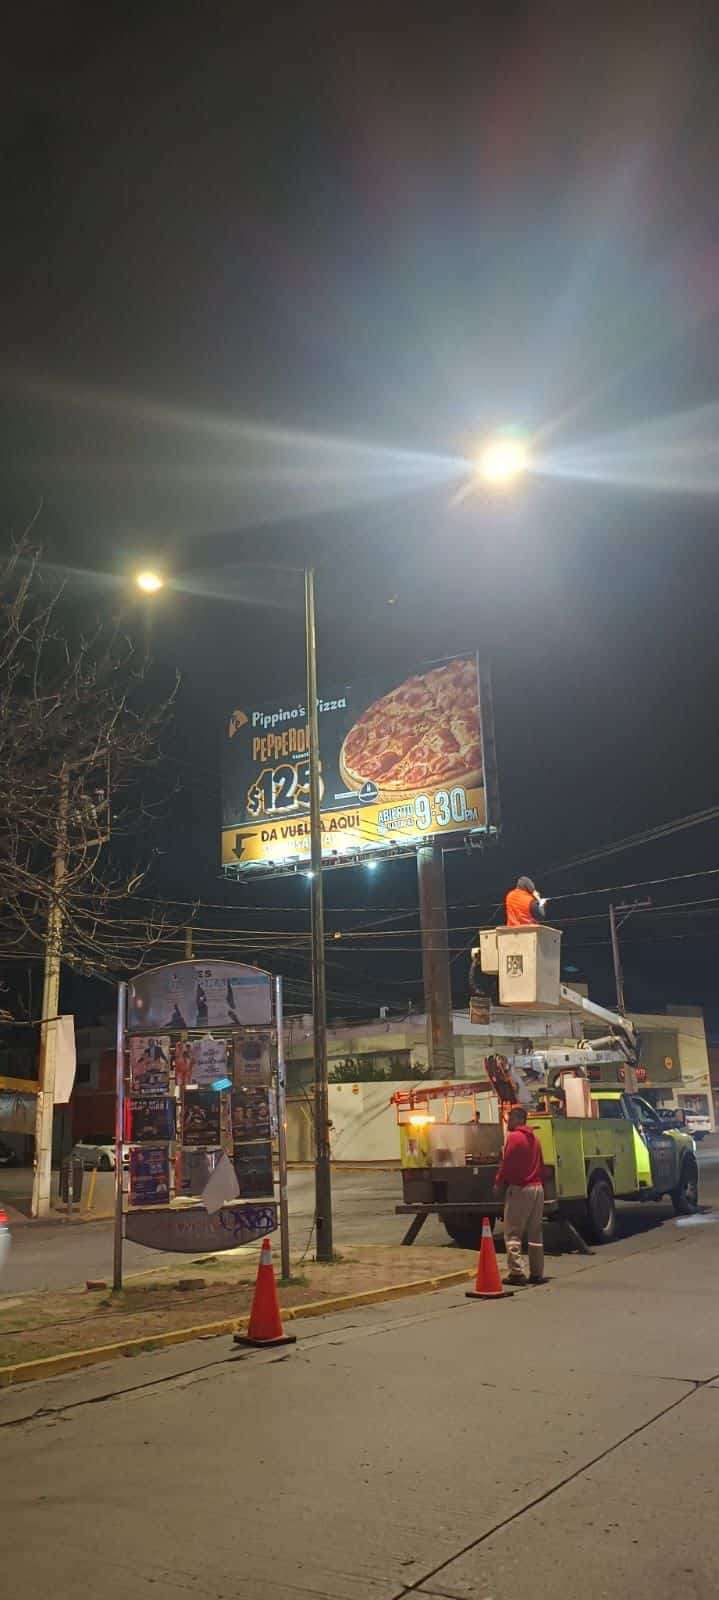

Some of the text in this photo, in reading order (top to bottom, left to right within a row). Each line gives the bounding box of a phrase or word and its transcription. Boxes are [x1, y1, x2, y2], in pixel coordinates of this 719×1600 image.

[252, 704, 305, 728] Pippino's
[316, 698, 346, 712] izza
[261, 828, 278, 843] DA
[280, 819, 325, 838] VUELA
